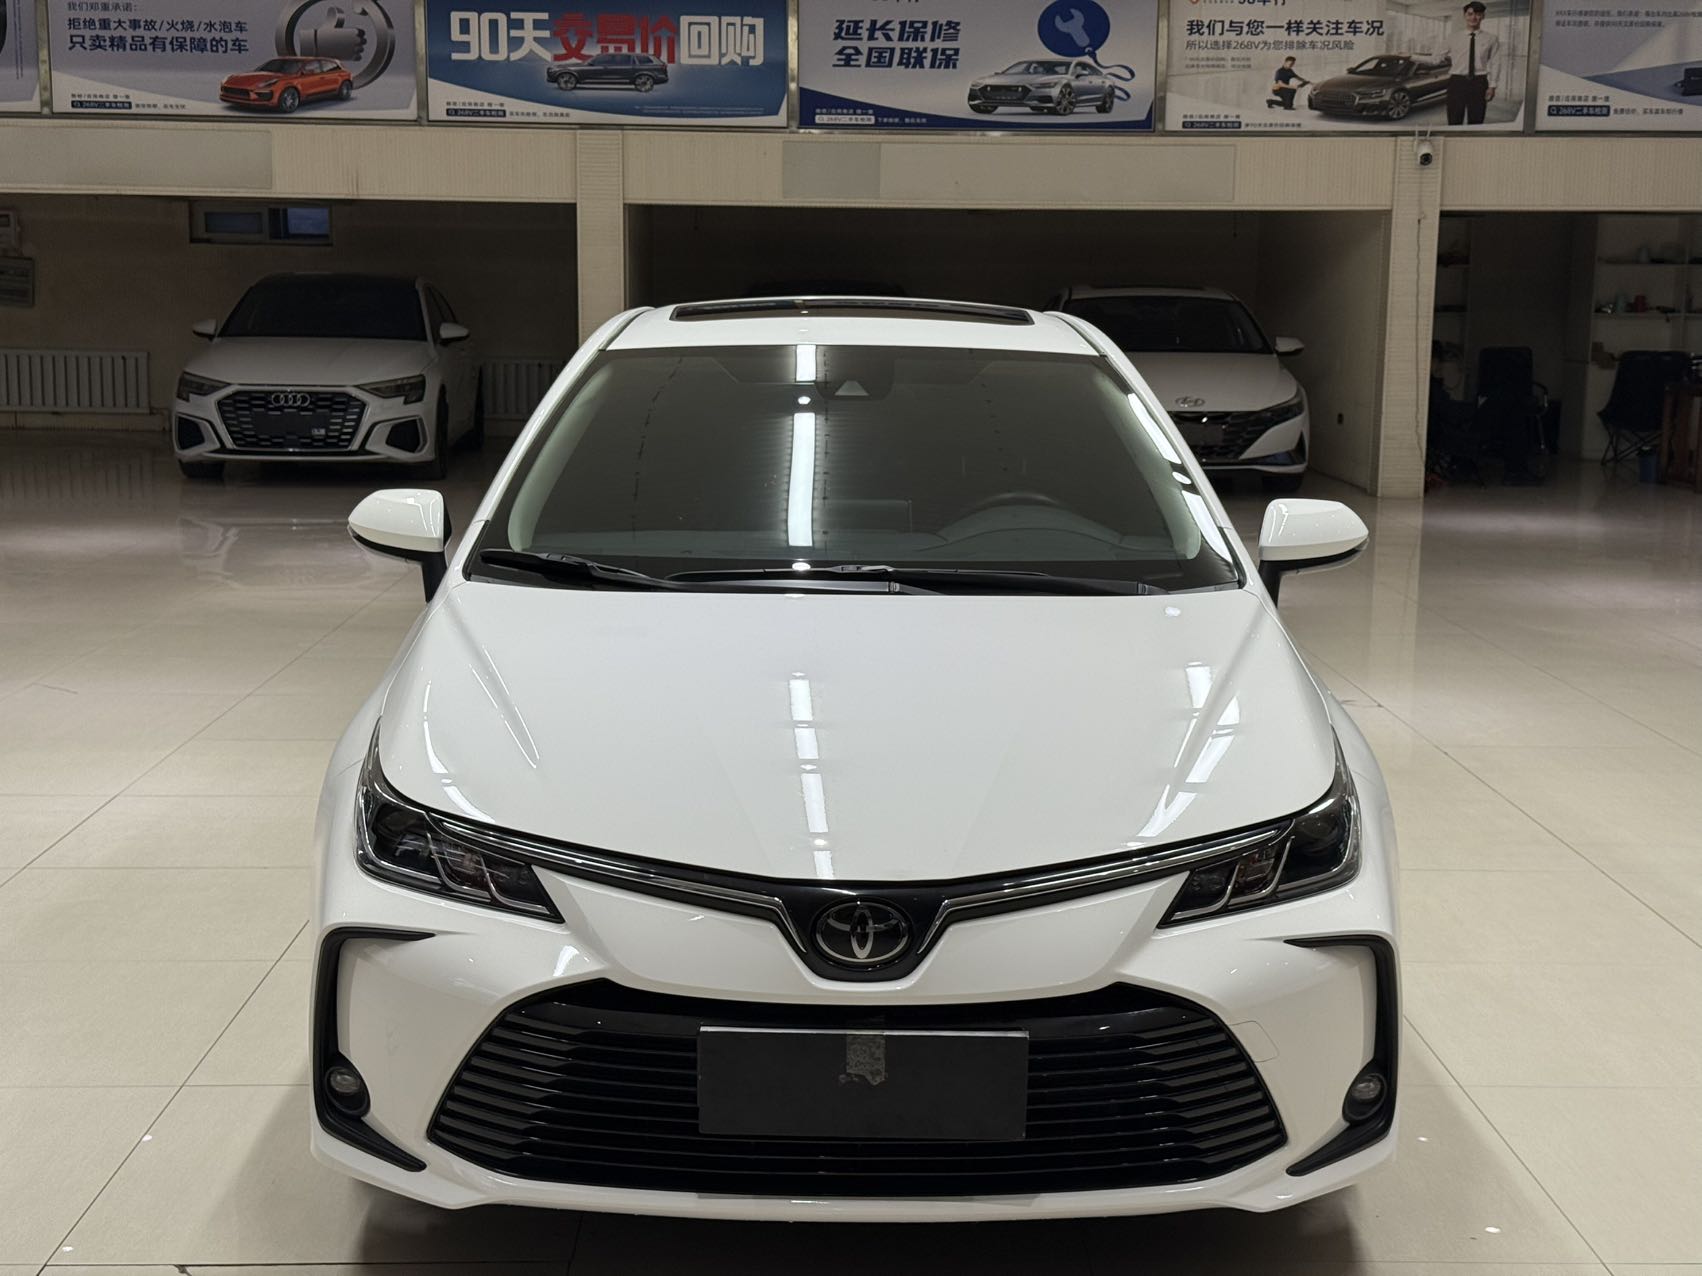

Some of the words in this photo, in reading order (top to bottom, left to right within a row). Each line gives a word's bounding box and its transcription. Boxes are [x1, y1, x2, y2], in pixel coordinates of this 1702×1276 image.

[67, 18, 249, 34] 拒绝重大事故/火烧/水泡车
[833, 19, 961, 42] 延长保修
[1186, 19, 1385, 37] 我们与您一样关注车况
[68, 34, 249, 54] 只卖精品有保障的车
[1185, 39, 1355, 51] 所以选择268V为您排除车况风险
[832, 45, 960, 69] 全国联保
